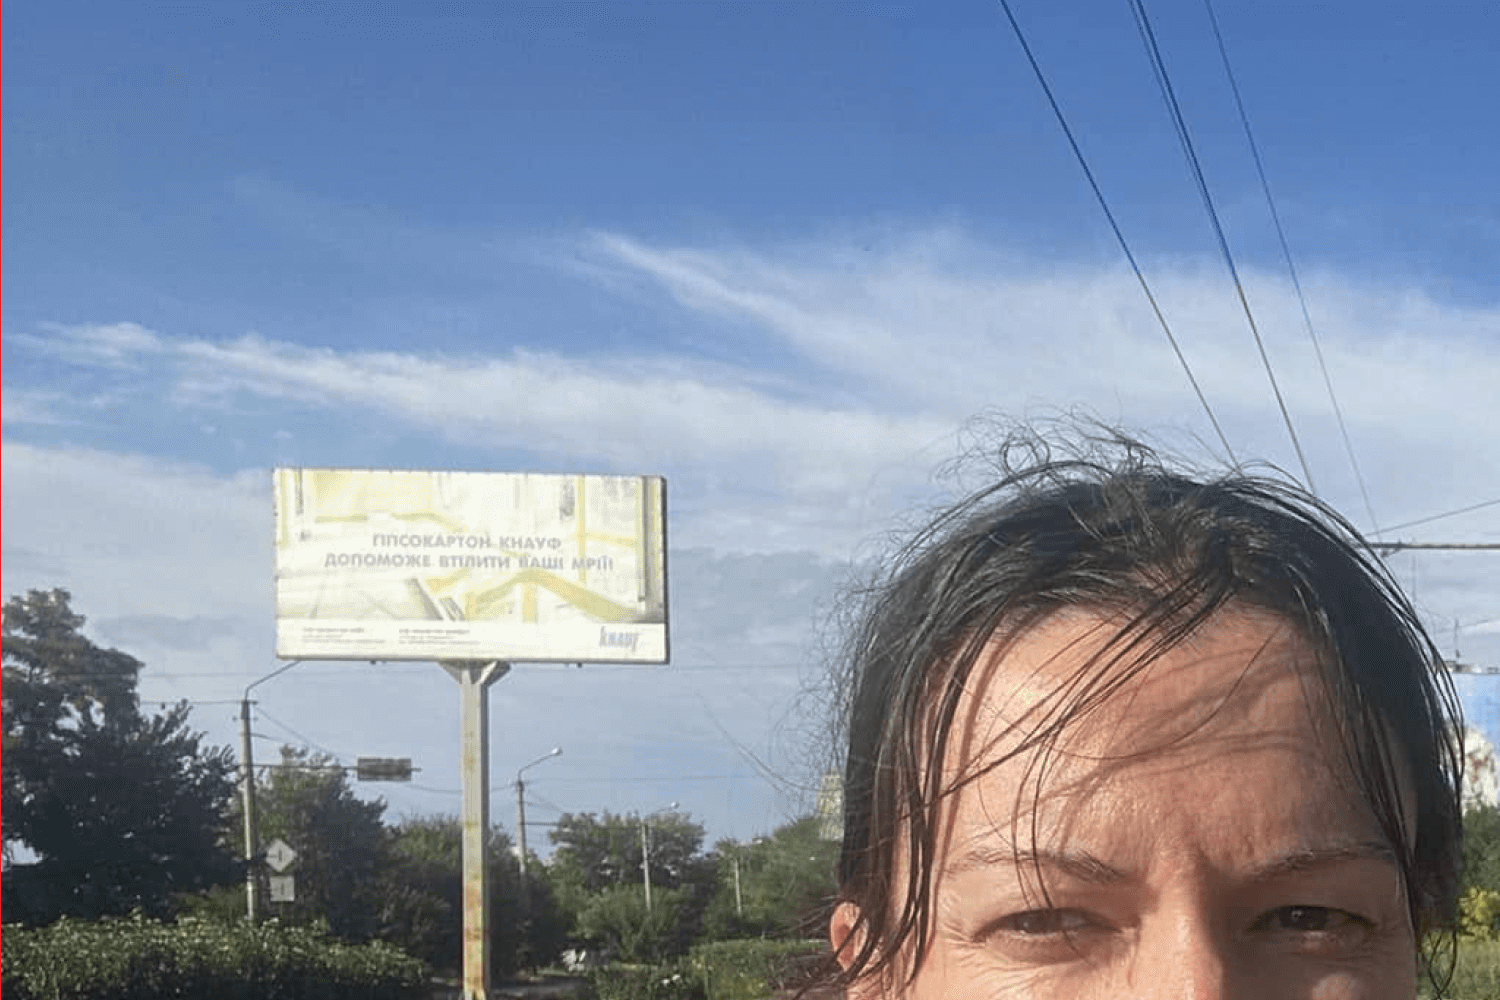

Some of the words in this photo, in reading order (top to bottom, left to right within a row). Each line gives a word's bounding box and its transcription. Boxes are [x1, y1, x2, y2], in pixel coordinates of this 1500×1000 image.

[499, 535, 562, 550] КНАУФ
[324, 553, 431, 568] ДОПОМОЖЕ
[438, 554, 510, 569] ВТІЛИТИ
[518, 556, 564, 570] ВАШІ
